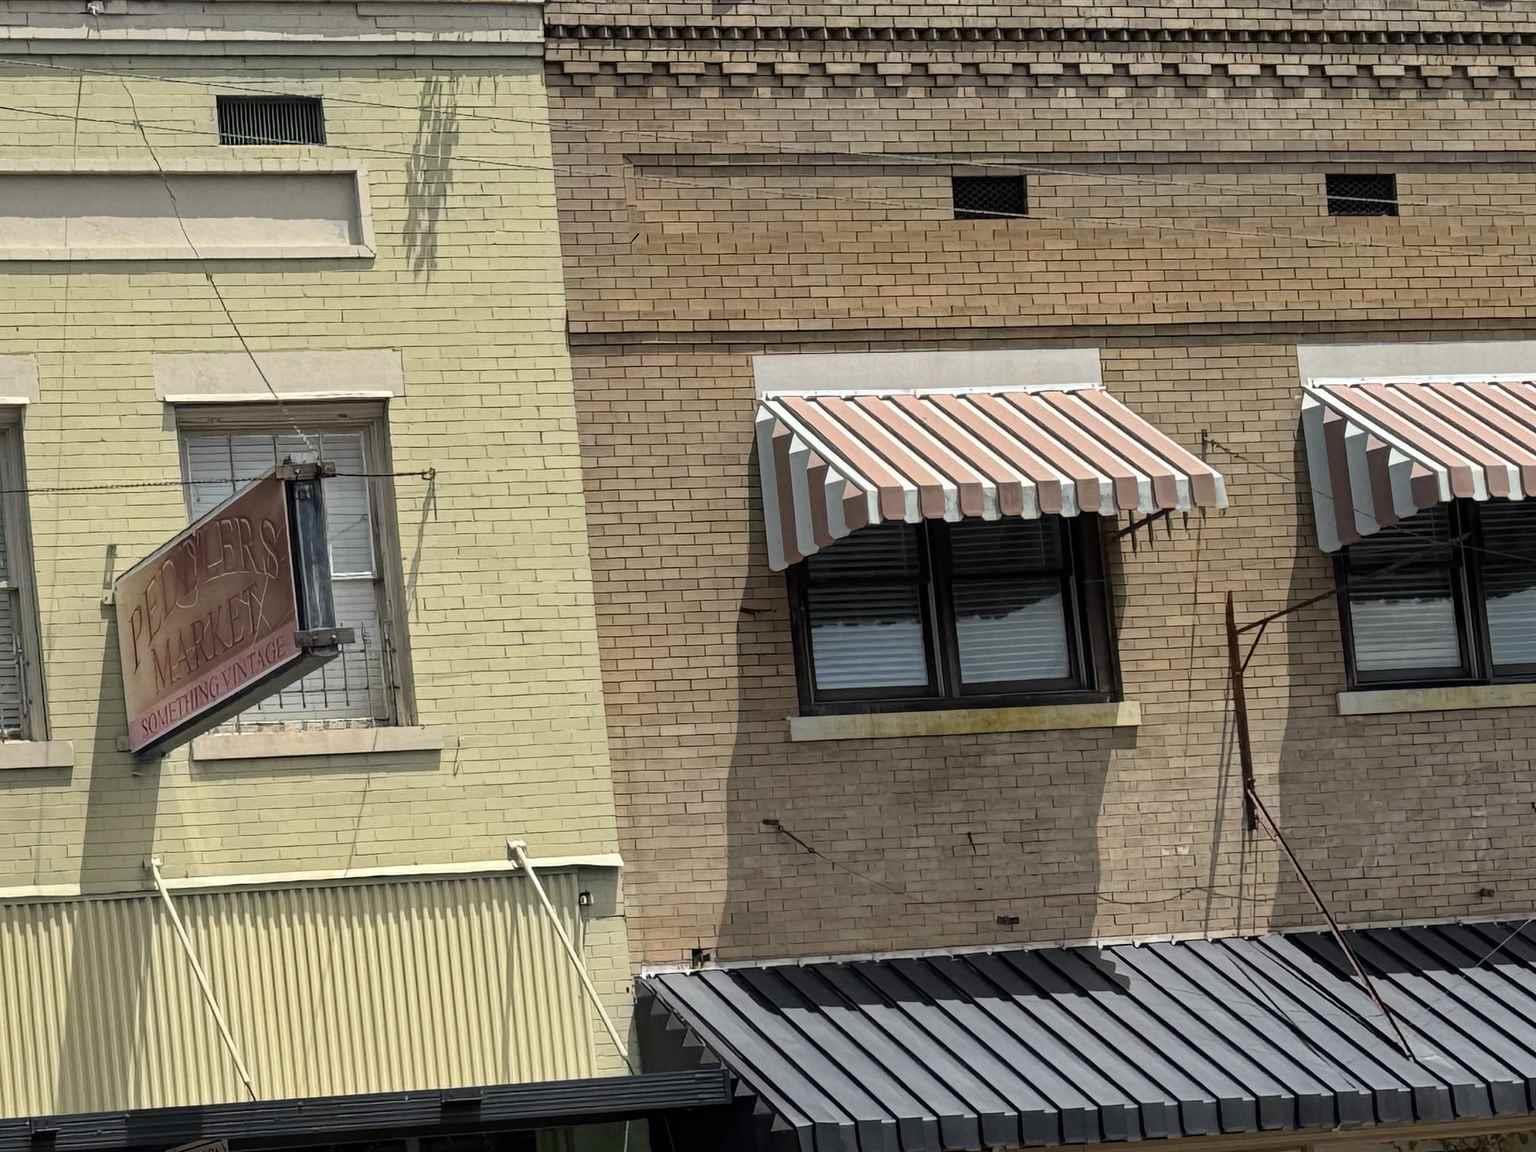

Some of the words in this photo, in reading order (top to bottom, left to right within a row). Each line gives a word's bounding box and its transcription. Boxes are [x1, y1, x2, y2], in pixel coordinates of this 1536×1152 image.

[141, 673, 219, 736] SOMETHING
[222, 635, 288, 691] VINTAGE
[150, 585, 266, 697] MARKET
